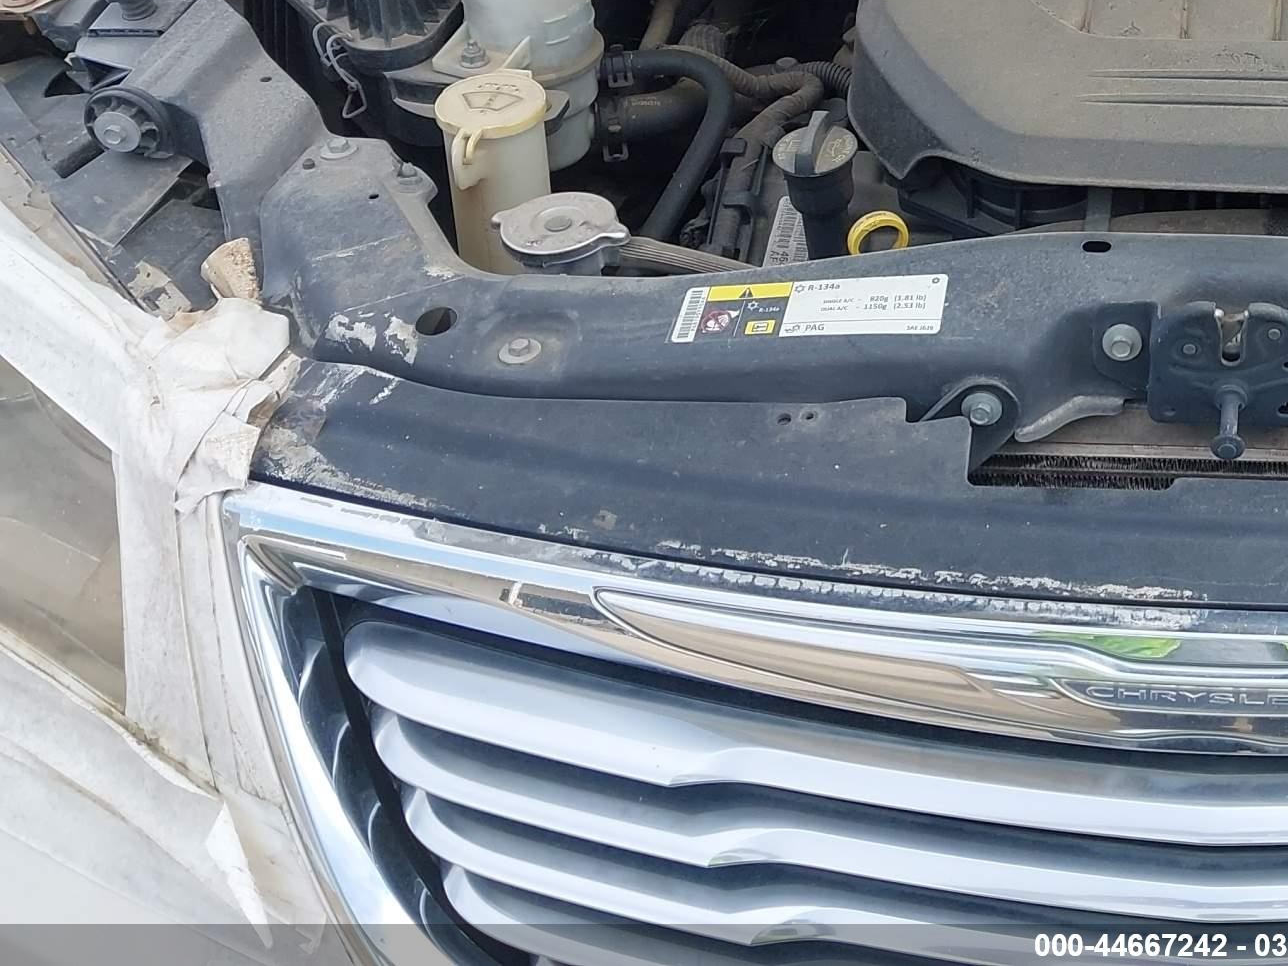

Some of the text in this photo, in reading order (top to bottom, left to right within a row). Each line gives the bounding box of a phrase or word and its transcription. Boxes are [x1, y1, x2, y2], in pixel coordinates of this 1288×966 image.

[807, 283, 841, 291] R-134a
[869, 295, 889, 303] 820g
[894, 294, 914, 302] (1.81
[915, 294, 927, 302] lb)
[864, 303, 888, 311] 1150g
[893, 302, 914, 310] (2.53
[915, 302, 926, 310] lb)
[804, 323, 825, 331] PAG
